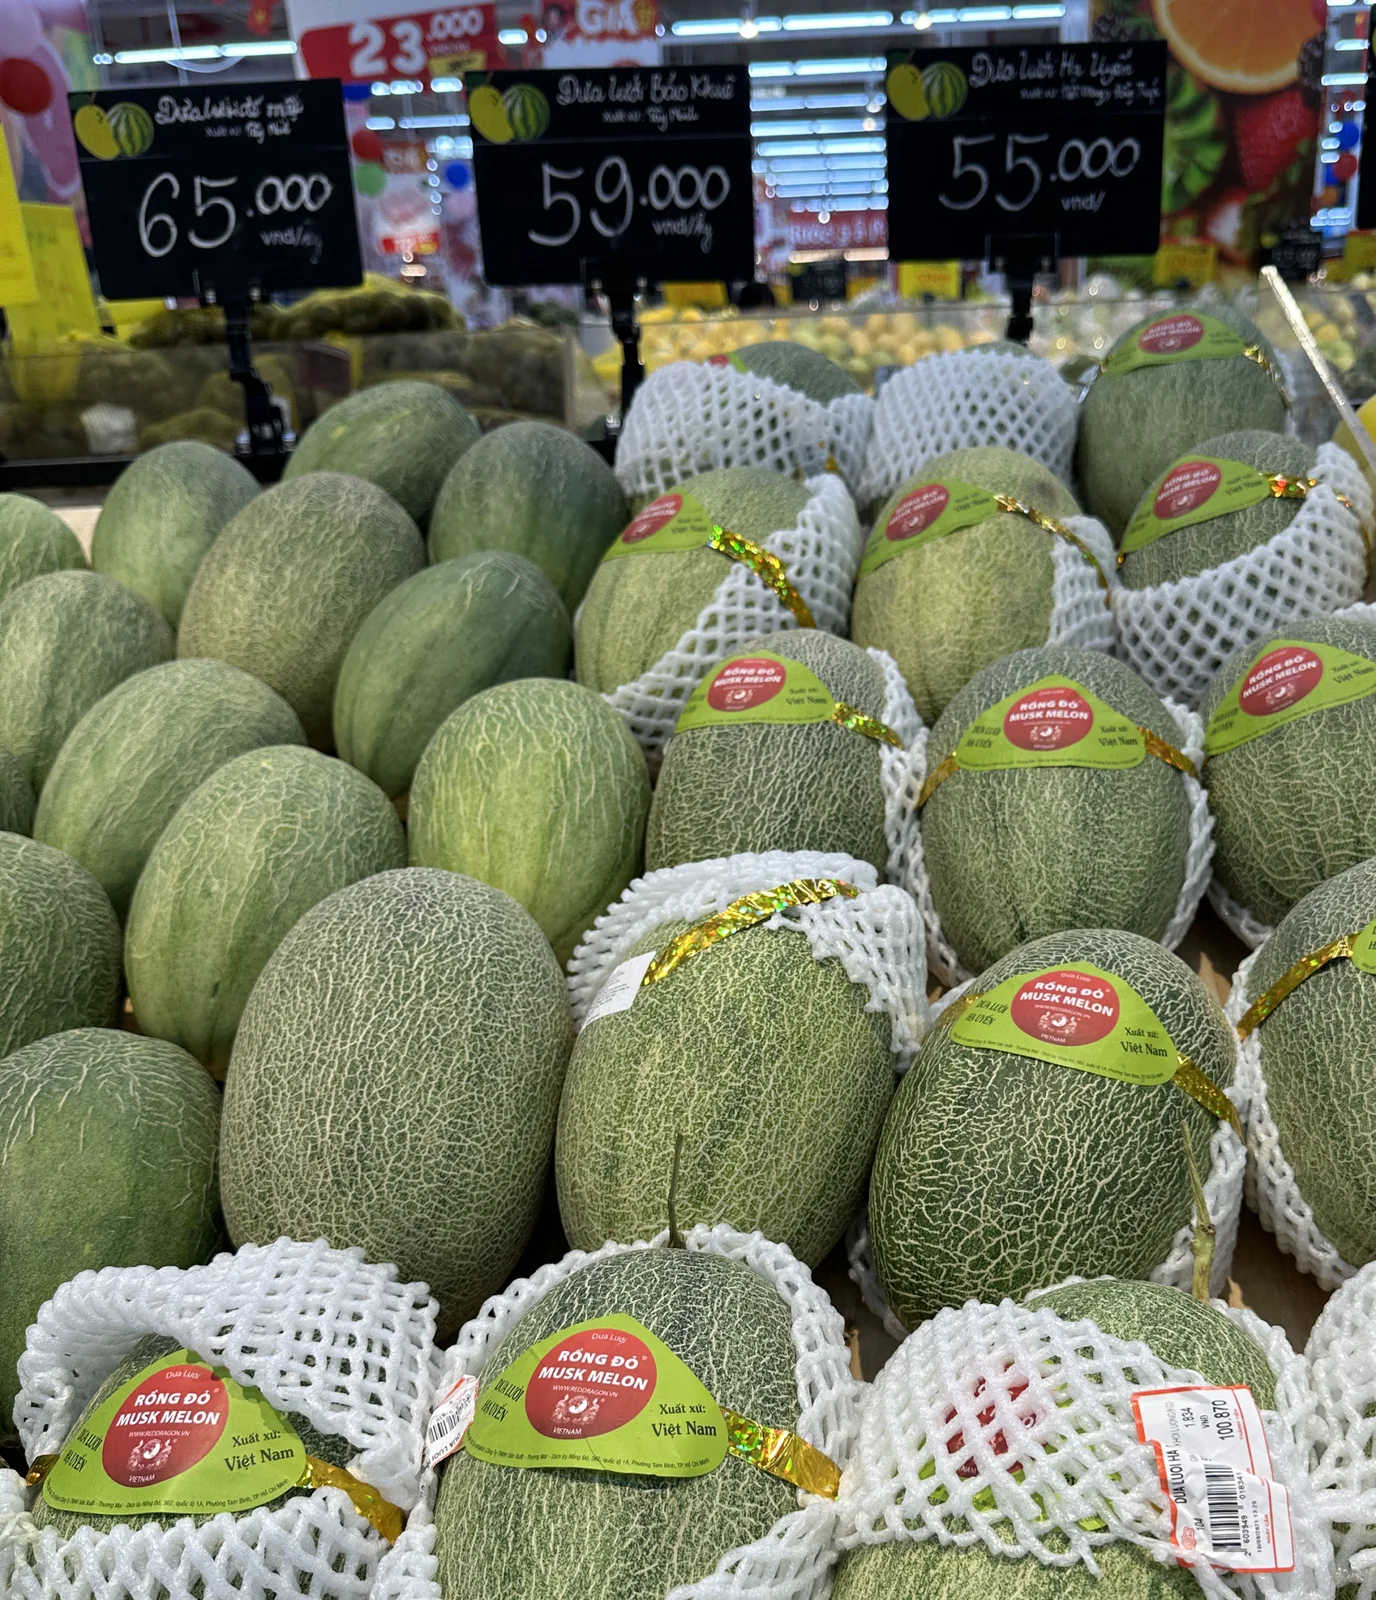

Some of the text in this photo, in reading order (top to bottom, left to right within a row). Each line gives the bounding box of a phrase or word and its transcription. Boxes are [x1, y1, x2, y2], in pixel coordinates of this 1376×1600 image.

[938, 132, 1141, 212] 55.000
[528, 154, 731, 247] 59.000
[138, 171, 333, 258] 65.000
[1242, 674, 1275, 699] MUSK
[1275, 659, 1318, 681] MELON
[1009, 709, 1090, 723] MUSK MELON
[1098, 735, 1138, 748] Việt Nam
[1019, 991, 1114, 1017] MUSK MELON
[1040, 1032, 1067, 1043] VIETNAM
[1124, 1026, 1145, 1038] Xuất
[1120, 1040, 1168, 1058] Việt Nam
[557, 1347, 639, 1370] RỒNG ĐỎ
[537, 1366, 649, 1391] MUSK MELON
[134, 1388, 211, 1407] RỒNG ĐỎ
[552, 1384, 619, 1398] WWW.REDDRAGON.VN
[115, 1409, 220, 1427] MUSK MELON
[659, 1402, 706, 1415] Xuất xứ:
[1180, 1406, 1196, 1428] 1.834
[651, 1420, 717, 1439] Việt Nam
[1211, 1399, 1235, 1441] 100.870
[128, 1429, 191, 1438] WWW.REDDRAGON.VN
[231, 1429, 282, 1448] Xuất xứ:
[553, 1425, 582, 1436] VIETNAM
[224, 1447, 295, 1472] Việt Nam
[1166, 1449, 1182, 1462] HA
[128, 1473, 156, 1483] VIETNAM
[1169, 1463, 1186, 1486] LUOI
[196, 1500, 205, 1508] 1A,
[205, 1499, 226, 1508] Phường
[226, 1498, 240, 1506] Tam
[276, 1478, 290, 1491] Minh
[1173, 1485, 1188, 1504] DUA
[1236, 1471, 1247, 1500] 018341
[1193, 1516, 1206, 1531] 104
